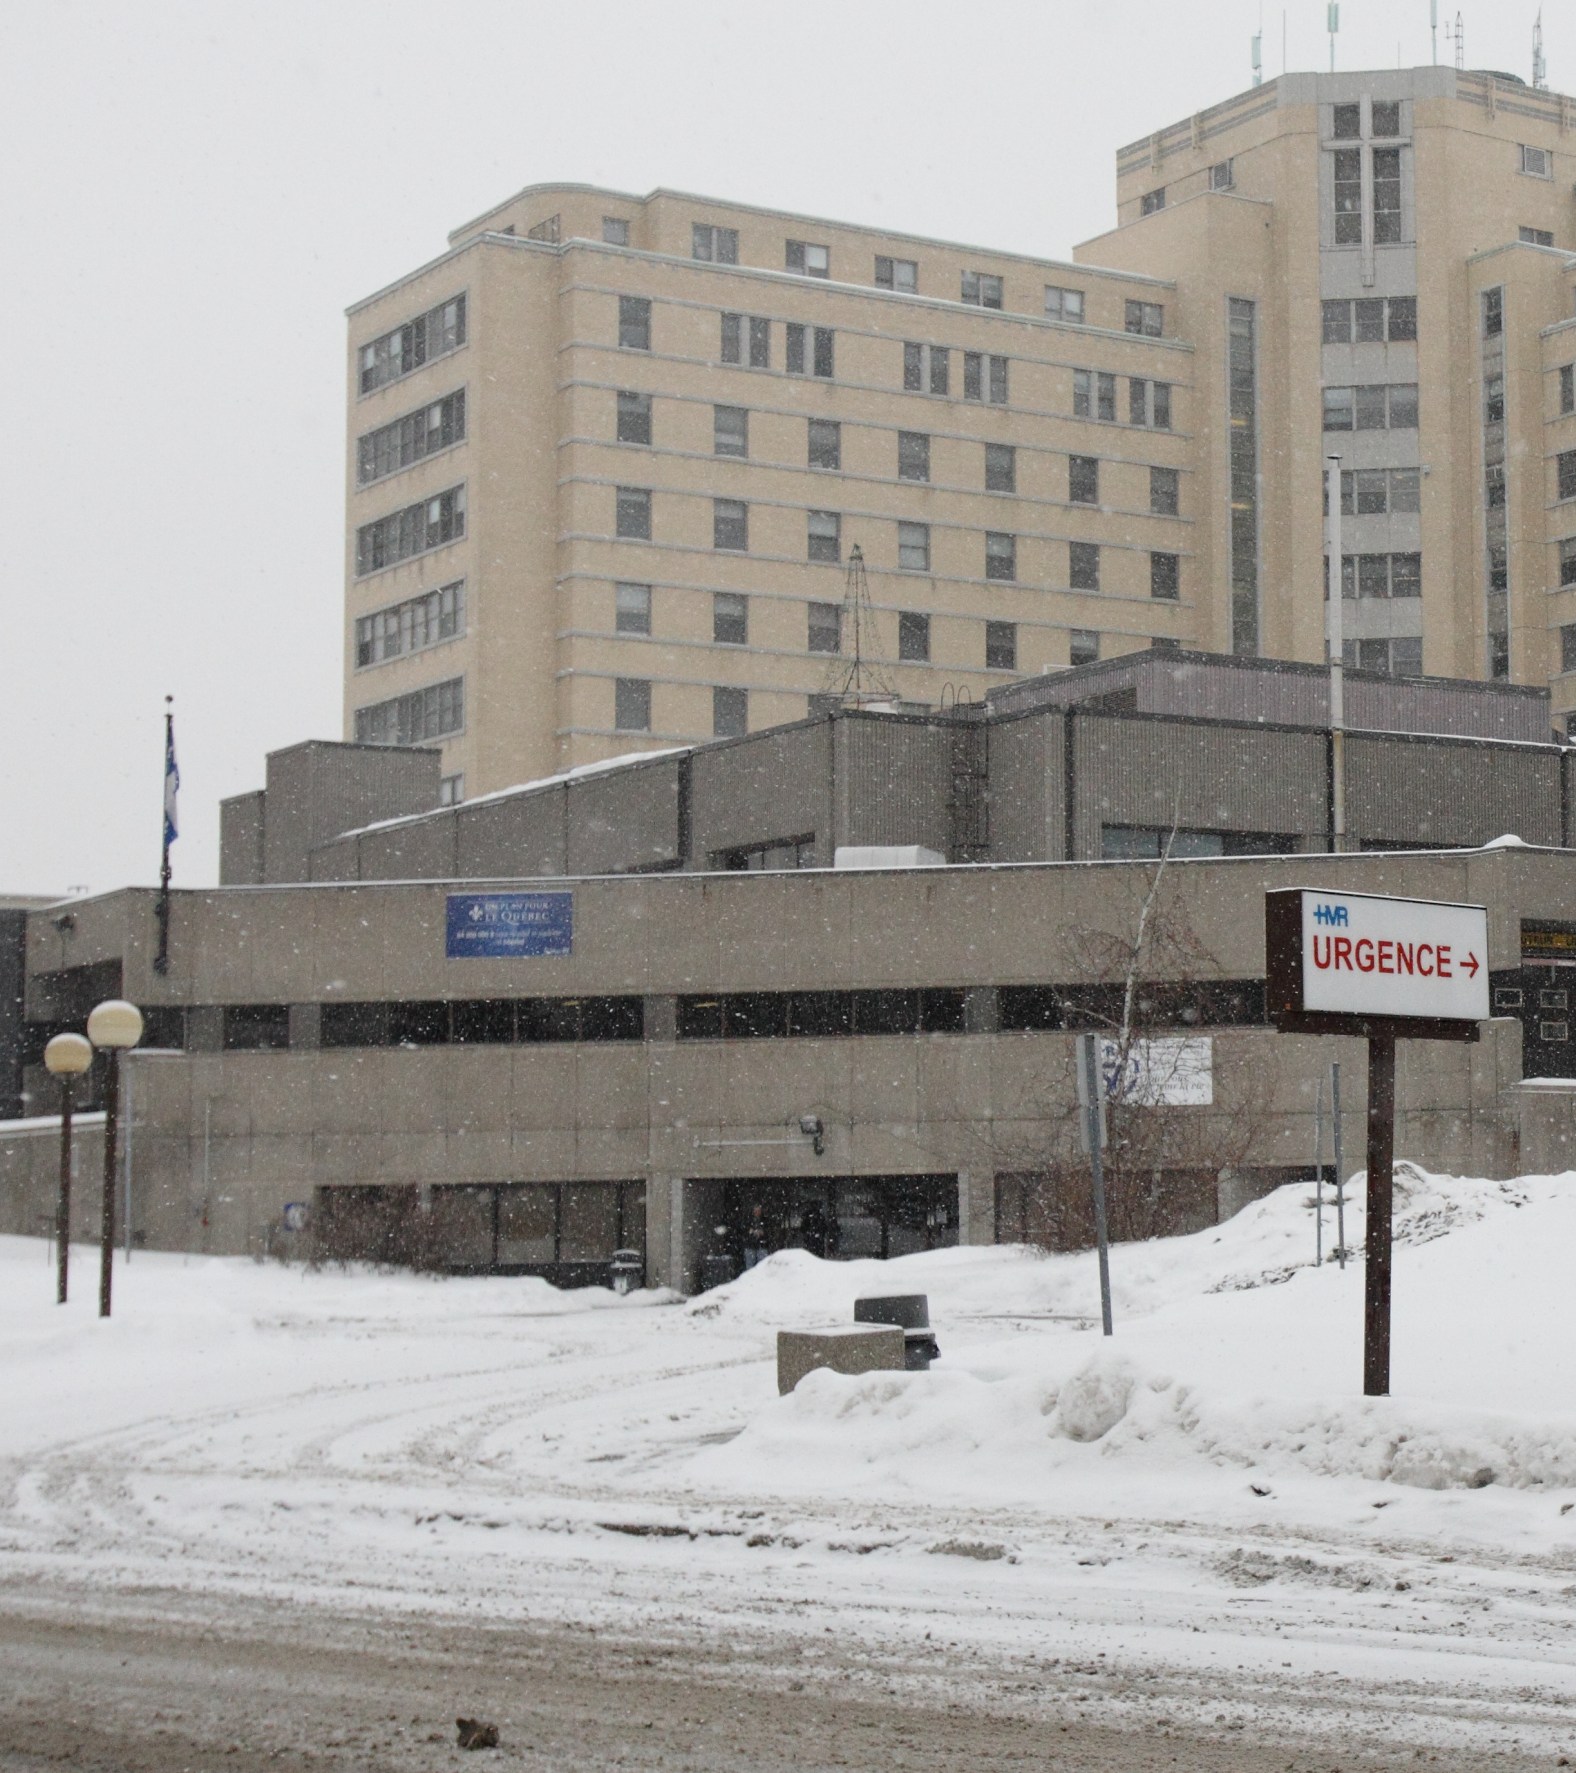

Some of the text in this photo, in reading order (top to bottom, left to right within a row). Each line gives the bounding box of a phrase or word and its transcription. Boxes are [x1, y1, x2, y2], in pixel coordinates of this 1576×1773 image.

[525, 901, 549, 910] POUR
[1313, 904, 1349, 927] HMR
[1313, 935, 1453, 978] URGENCE
